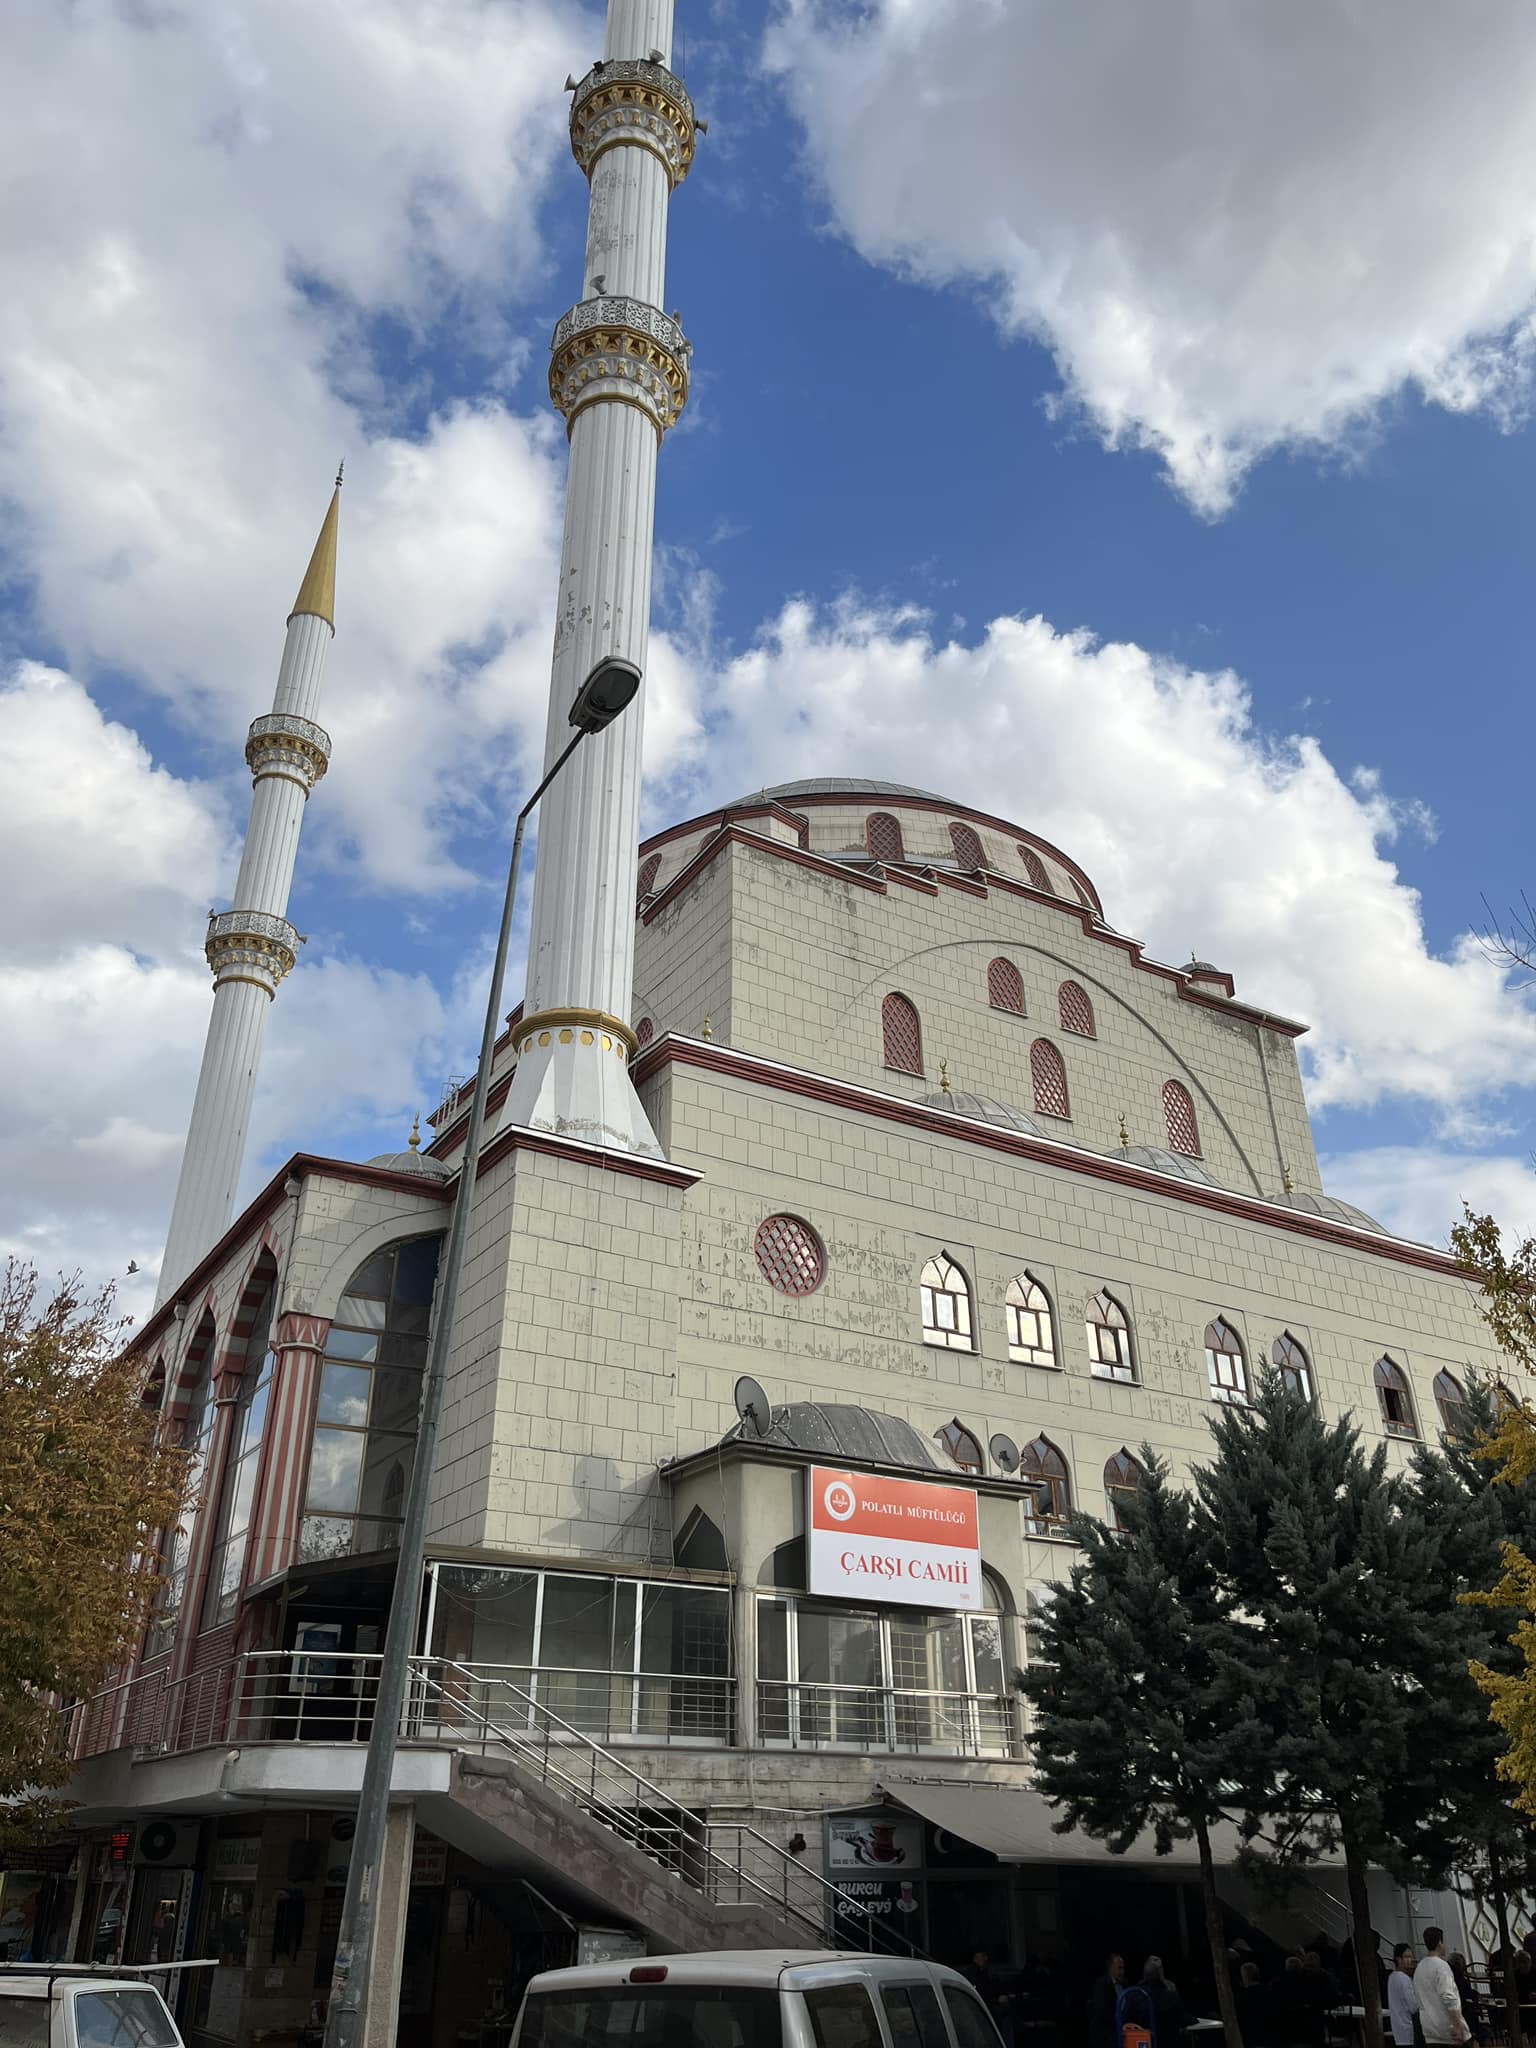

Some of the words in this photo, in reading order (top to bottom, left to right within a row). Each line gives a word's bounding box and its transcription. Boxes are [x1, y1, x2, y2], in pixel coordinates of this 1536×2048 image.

[862, 1500, 903, 1516] POLATLI
[907, 1506, 966, 1524] MÜFTÜLÜĞÜ
[840, 1551, 902, 1580] ÇARŞI
[908, 1559, 968, 1585] CAMİİ
